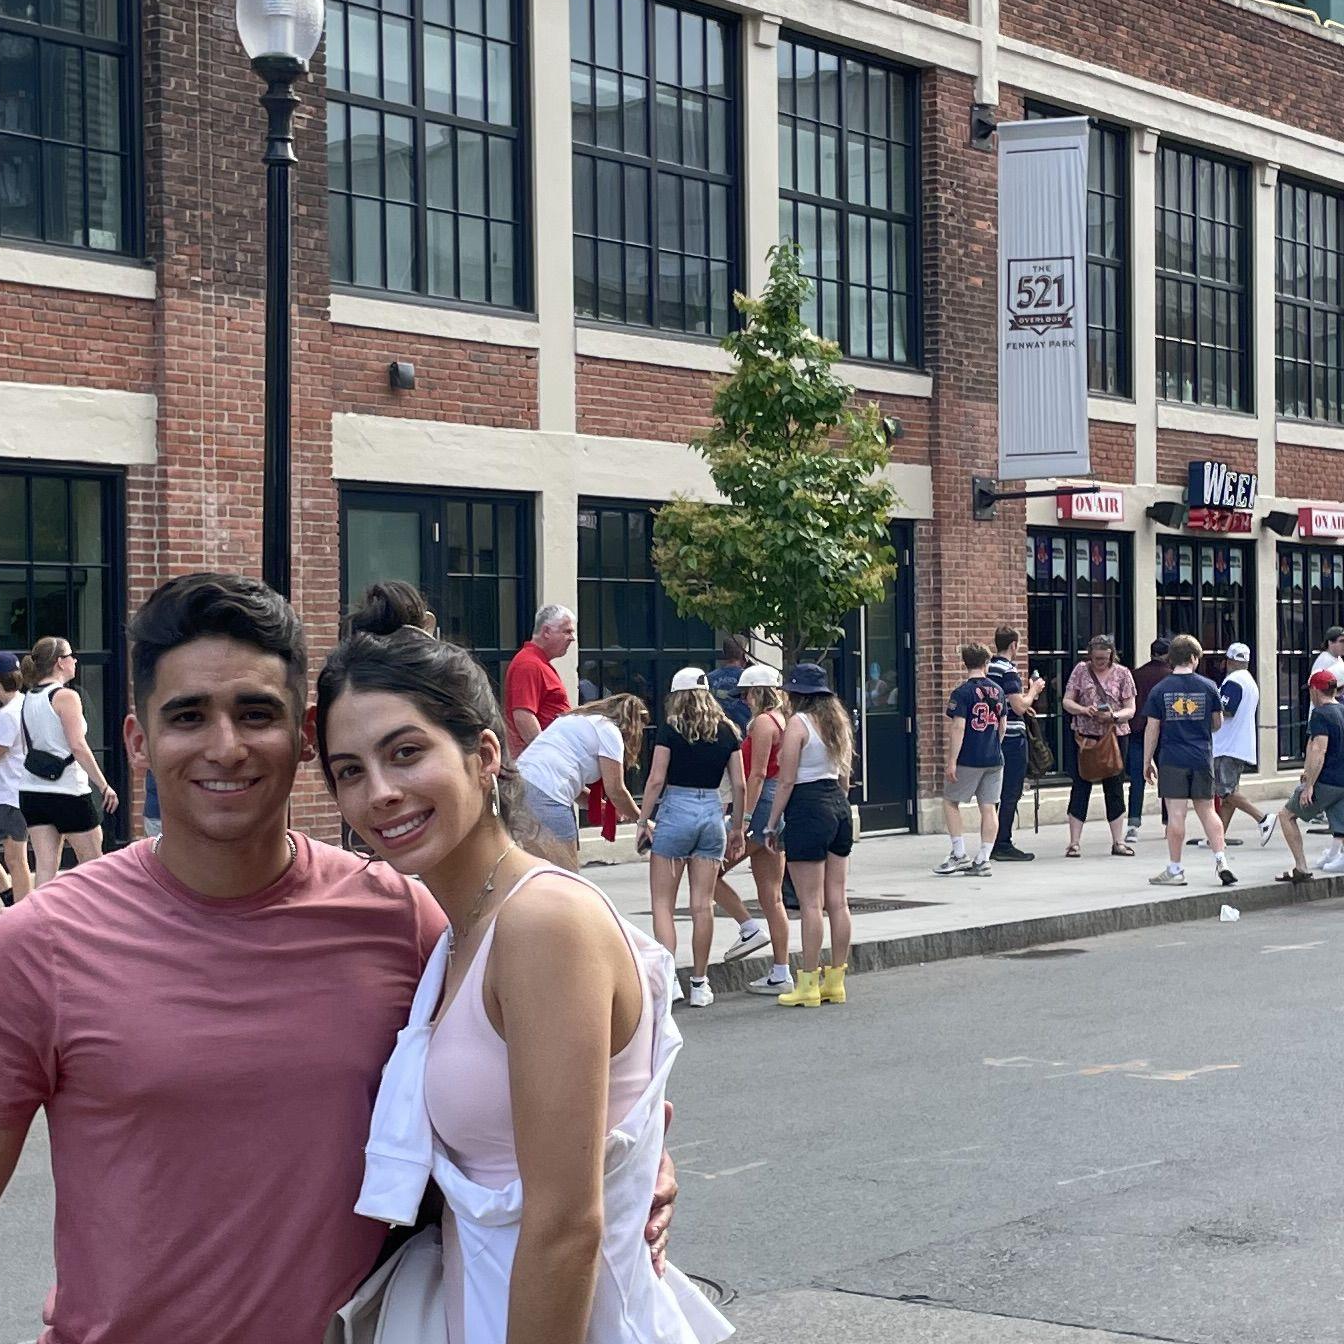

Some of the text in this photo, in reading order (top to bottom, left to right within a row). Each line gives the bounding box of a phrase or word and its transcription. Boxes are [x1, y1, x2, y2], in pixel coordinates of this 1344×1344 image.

[1017, 274, 1064, 308] 521
[1018, 316, 1062, 324] OVERLOOK
[1006, 339, 1076, 350] FENWAY PARK
[1076, 495, 1119, 513] ON AIR
[1315, 514, 1328, 529] ON
